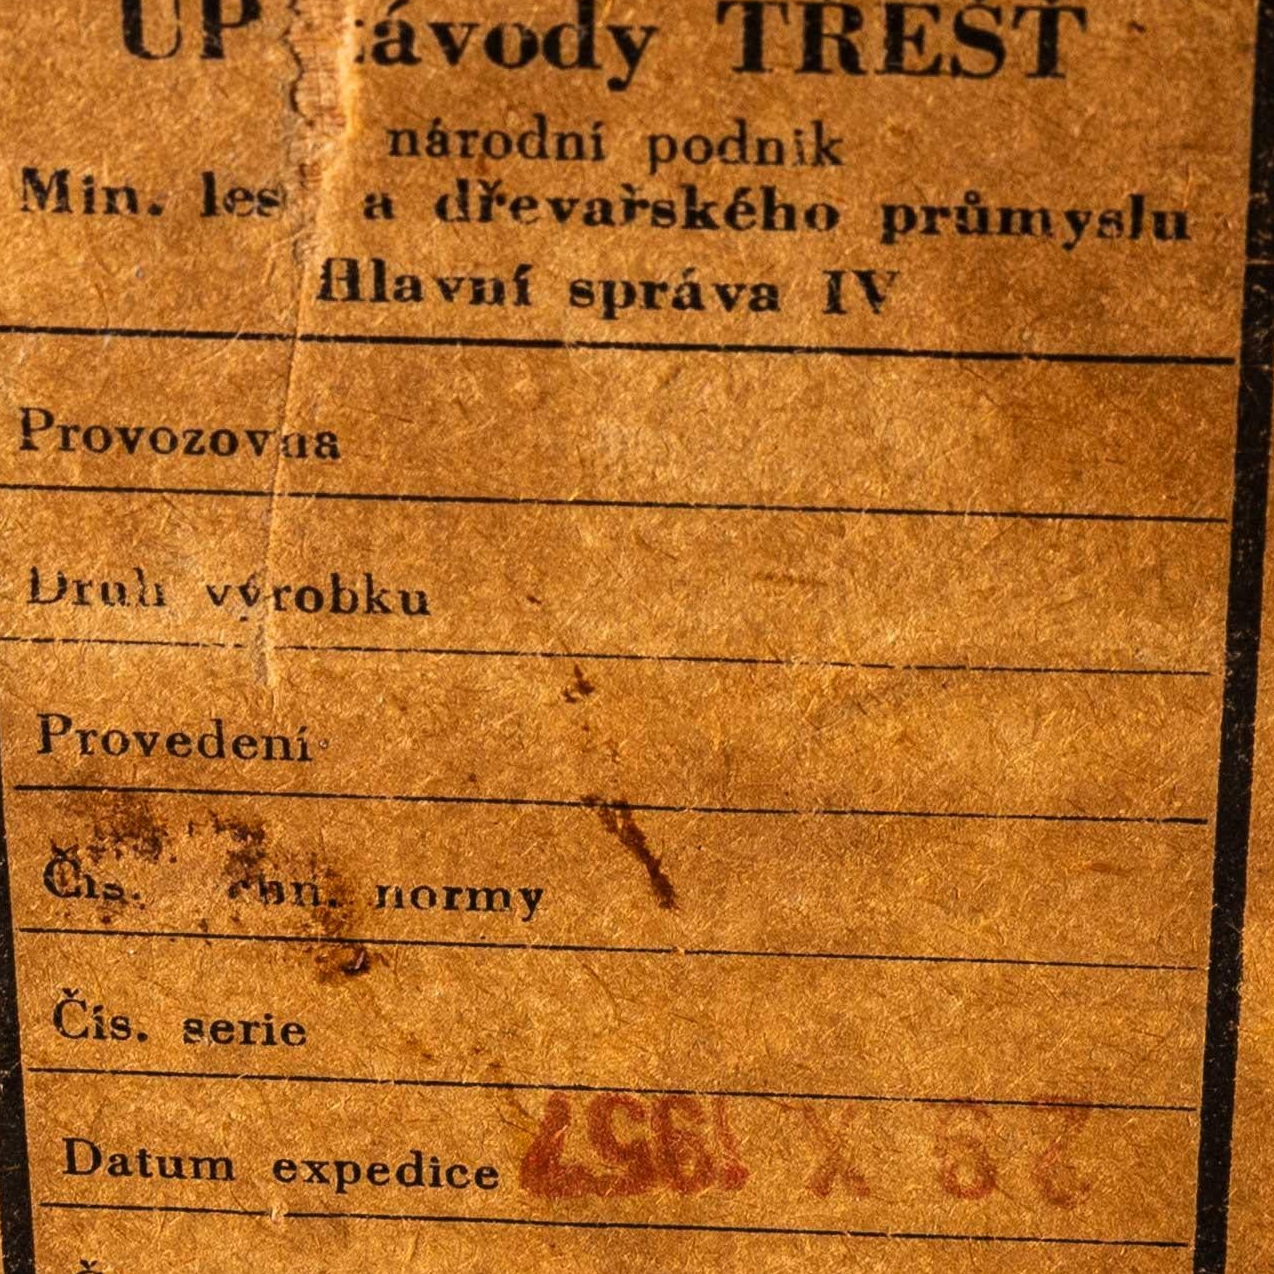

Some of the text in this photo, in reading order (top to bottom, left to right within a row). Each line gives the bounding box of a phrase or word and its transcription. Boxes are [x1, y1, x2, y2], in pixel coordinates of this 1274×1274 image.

[389, 113, 842, 174] národní podnik
[22, 167, 1189, 251] Min. les a dřevařského průmyslu
[569, 268, 779, 321] správa
[825, 269, 900, 315] IV
[21, 408, 340, 460] Provozovna
[38, 713, 311, 762] Provedení
[374, 882, 545, 923] normy
[53, 988, 306, 1046] Čís. serie
[64, 1137, 498, 1194] Datum expedice
